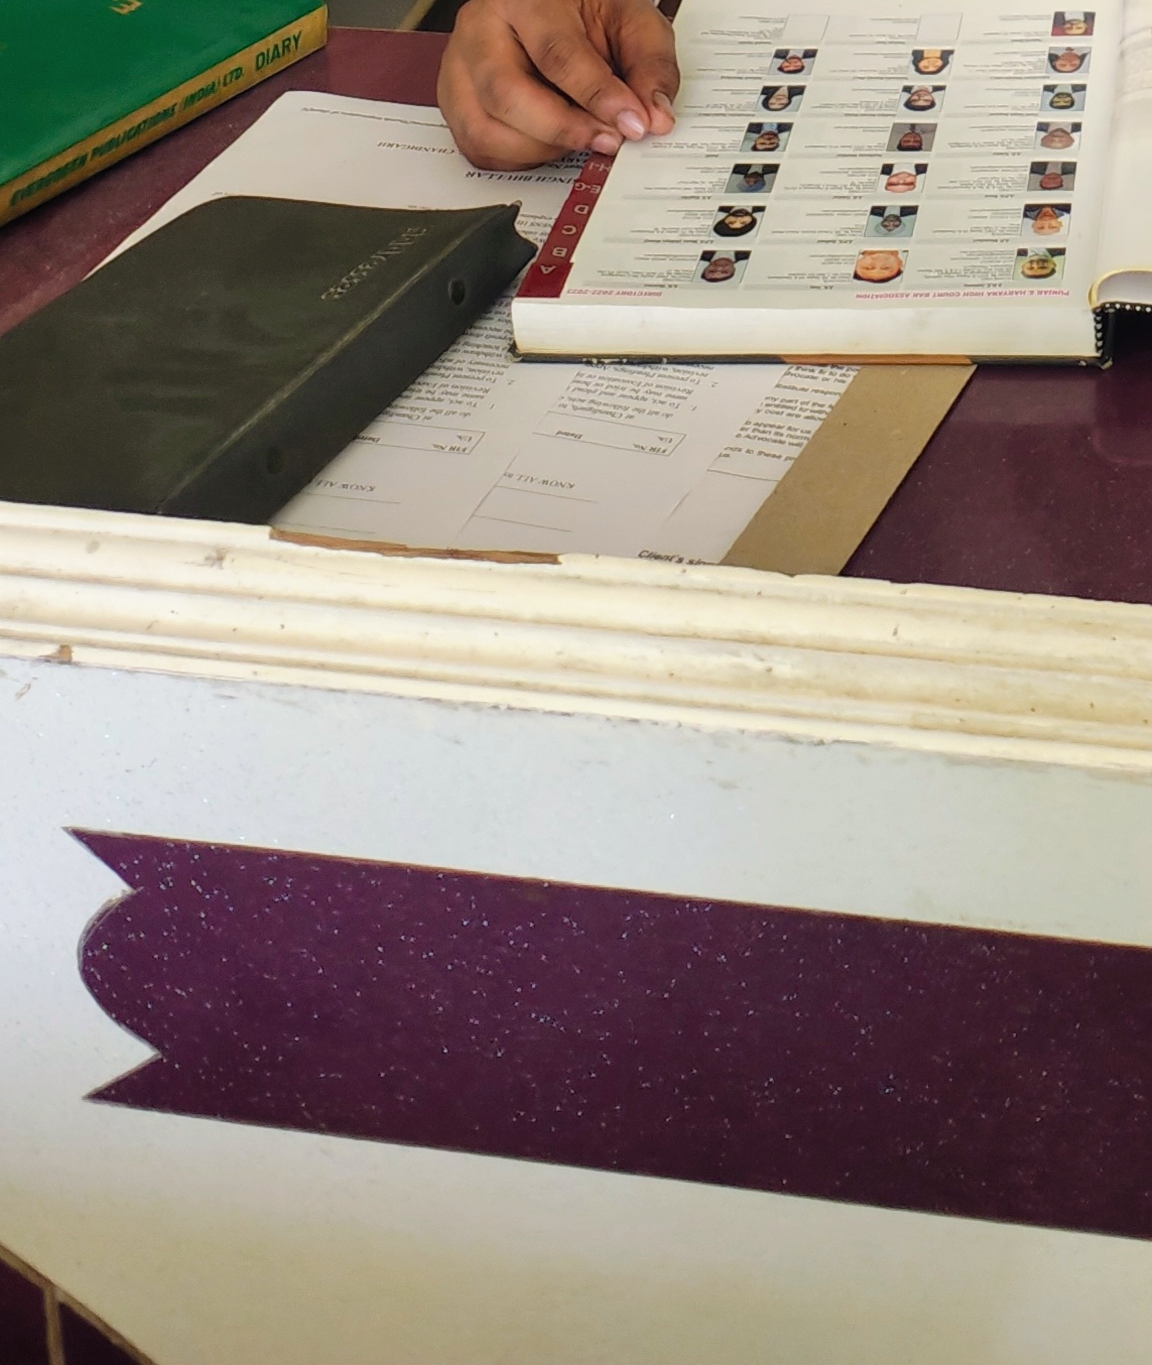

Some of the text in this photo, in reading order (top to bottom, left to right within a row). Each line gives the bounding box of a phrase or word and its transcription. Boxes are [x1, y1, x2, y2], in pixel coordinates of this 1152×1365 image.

[255, 30, 303, 72] DIARY
[375, 141, 454, 156] CHANDIGARH
[464, 170, 575, 184] INGH BHULLAR
[571, 182, 600, 194] E-G
[572, 204, 589, 215] D
[560, 224, 576, 235] C
[550, 246, 567, 257] B
[538, 264, 555, 275] A
[565, 289, 662, 298] DIRECTORY 2022-2023
[855, 292, 911, 300] ASSOCIATION
[962, 290, 985, 298] HIGH
[555, 430, 583, 440] Dated
[449, 445, 467, 453] FIR
[649, 445, 668, 454] FIR
[515, 474, 537, 485] ALL
[538, 479, 575, 490] KNOW
[341, 483, 375, 492] KNOW
